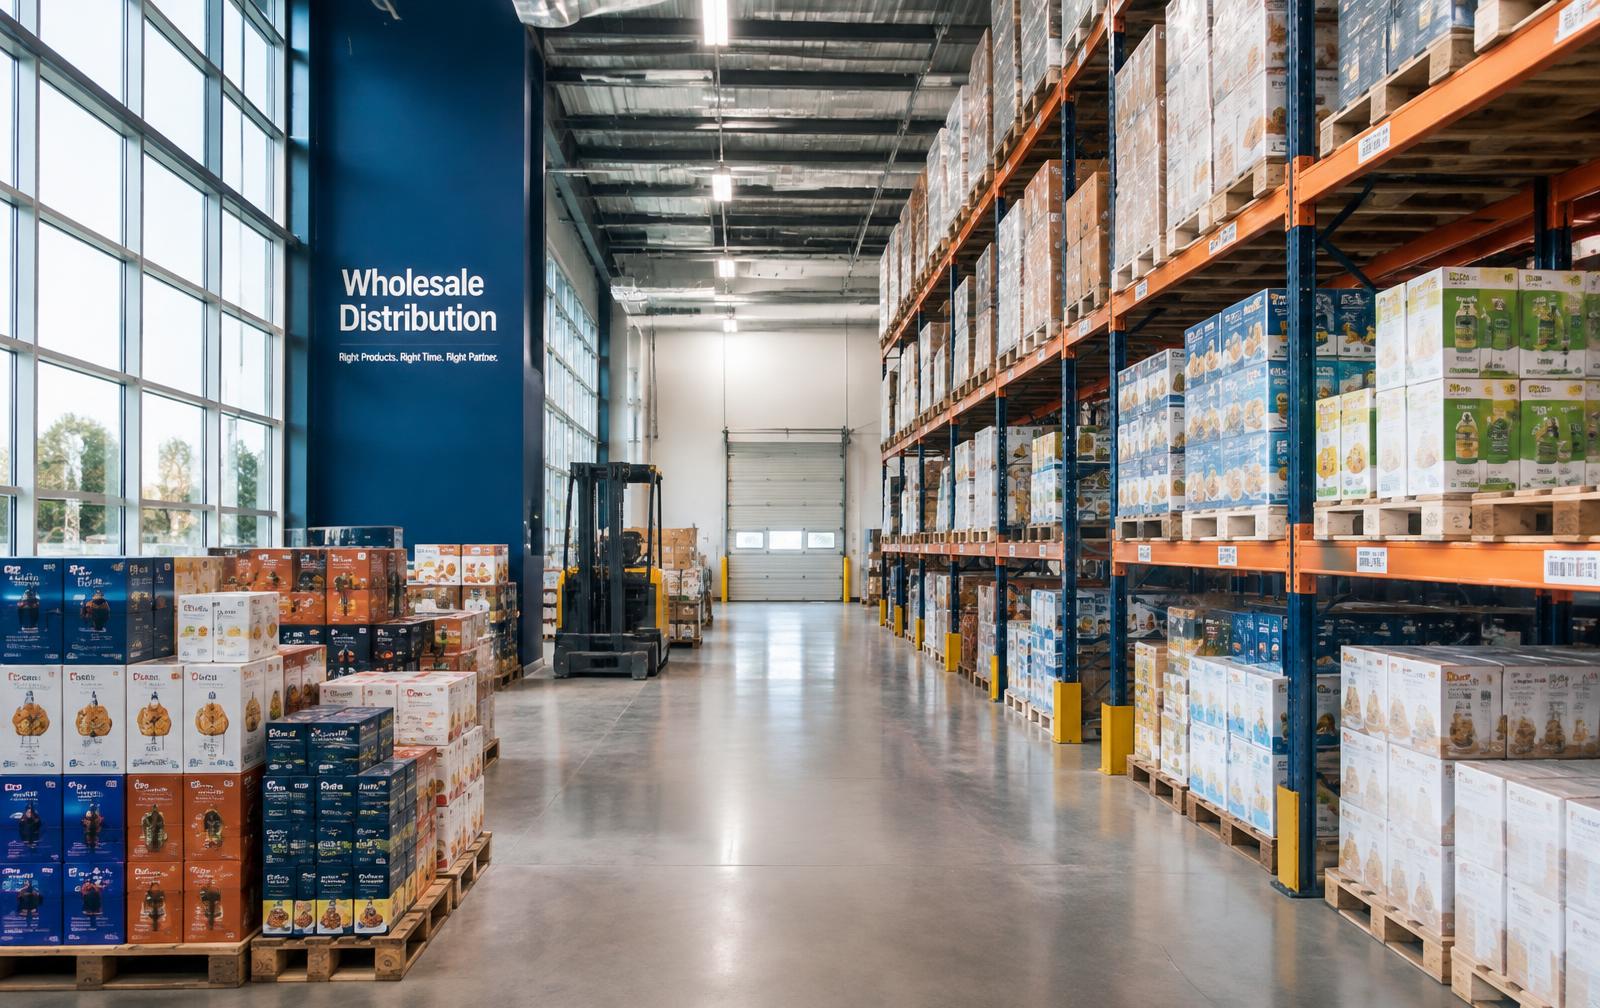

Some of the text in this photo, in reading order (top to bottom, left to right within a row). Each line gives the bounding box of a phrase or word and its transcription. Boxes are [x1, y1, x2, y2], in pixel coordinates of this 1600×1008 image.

[341, 268, 484, 297] Wholesale
[340, 303, 497, 332] Distribution
[338, 352, 498, 364] Right Products. Right Time. Right Partner.
